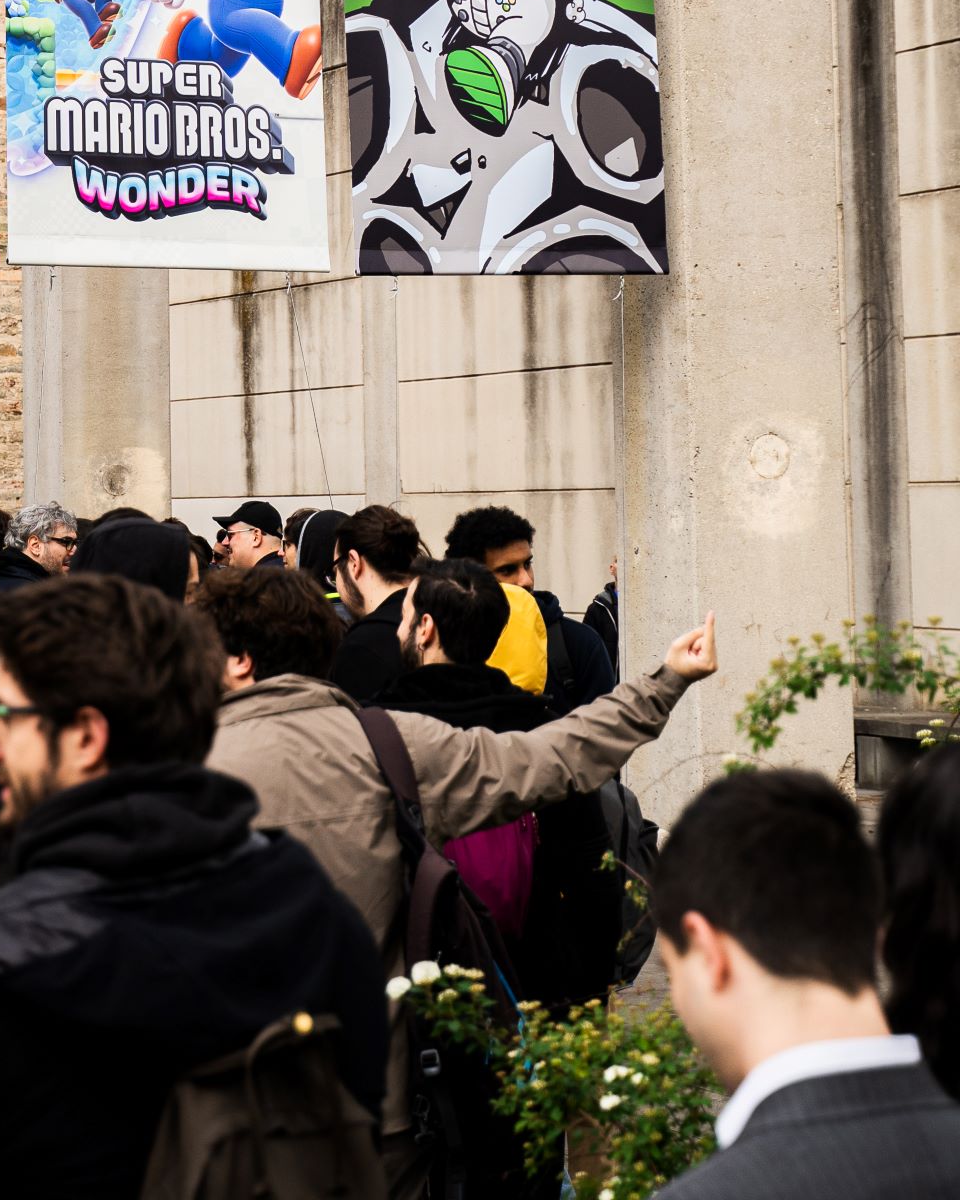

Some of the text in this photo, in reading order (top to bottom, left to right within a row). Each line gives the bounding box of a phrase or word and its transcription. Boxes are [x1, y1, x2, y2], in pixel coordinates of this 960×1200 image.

[102, 57, 223, 98] SUPER
[45, 98, 283, 161] MARIO BROS.
[72, 155, 263, 215] WONDER
